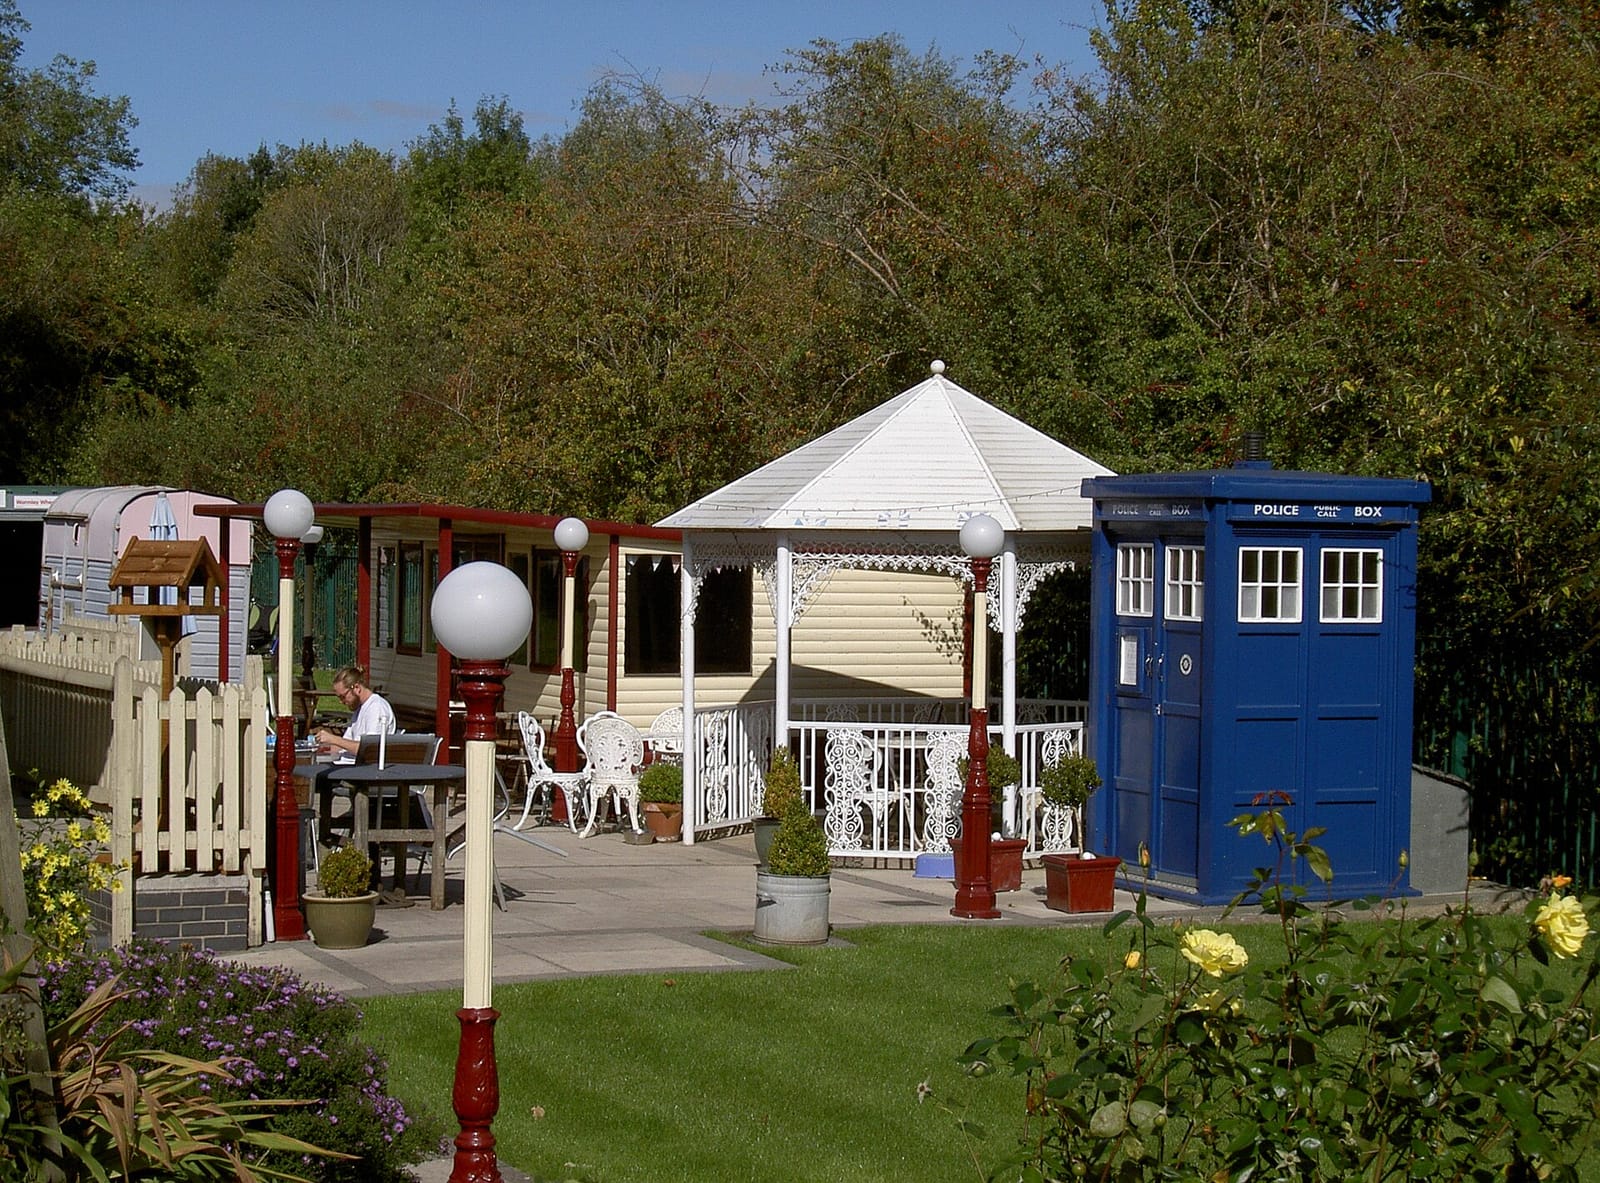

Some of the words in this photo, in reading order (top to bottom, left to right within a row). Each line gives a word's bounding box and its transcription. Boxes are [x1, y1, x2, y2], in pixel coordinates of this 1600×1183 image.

[1112, 504, 1139, 515] POLICE
[1171, 504, 1190, 515] BOX
[1254, 504, 1300, 516] POLICE
[1354, 506, 1382, 517] BOX
